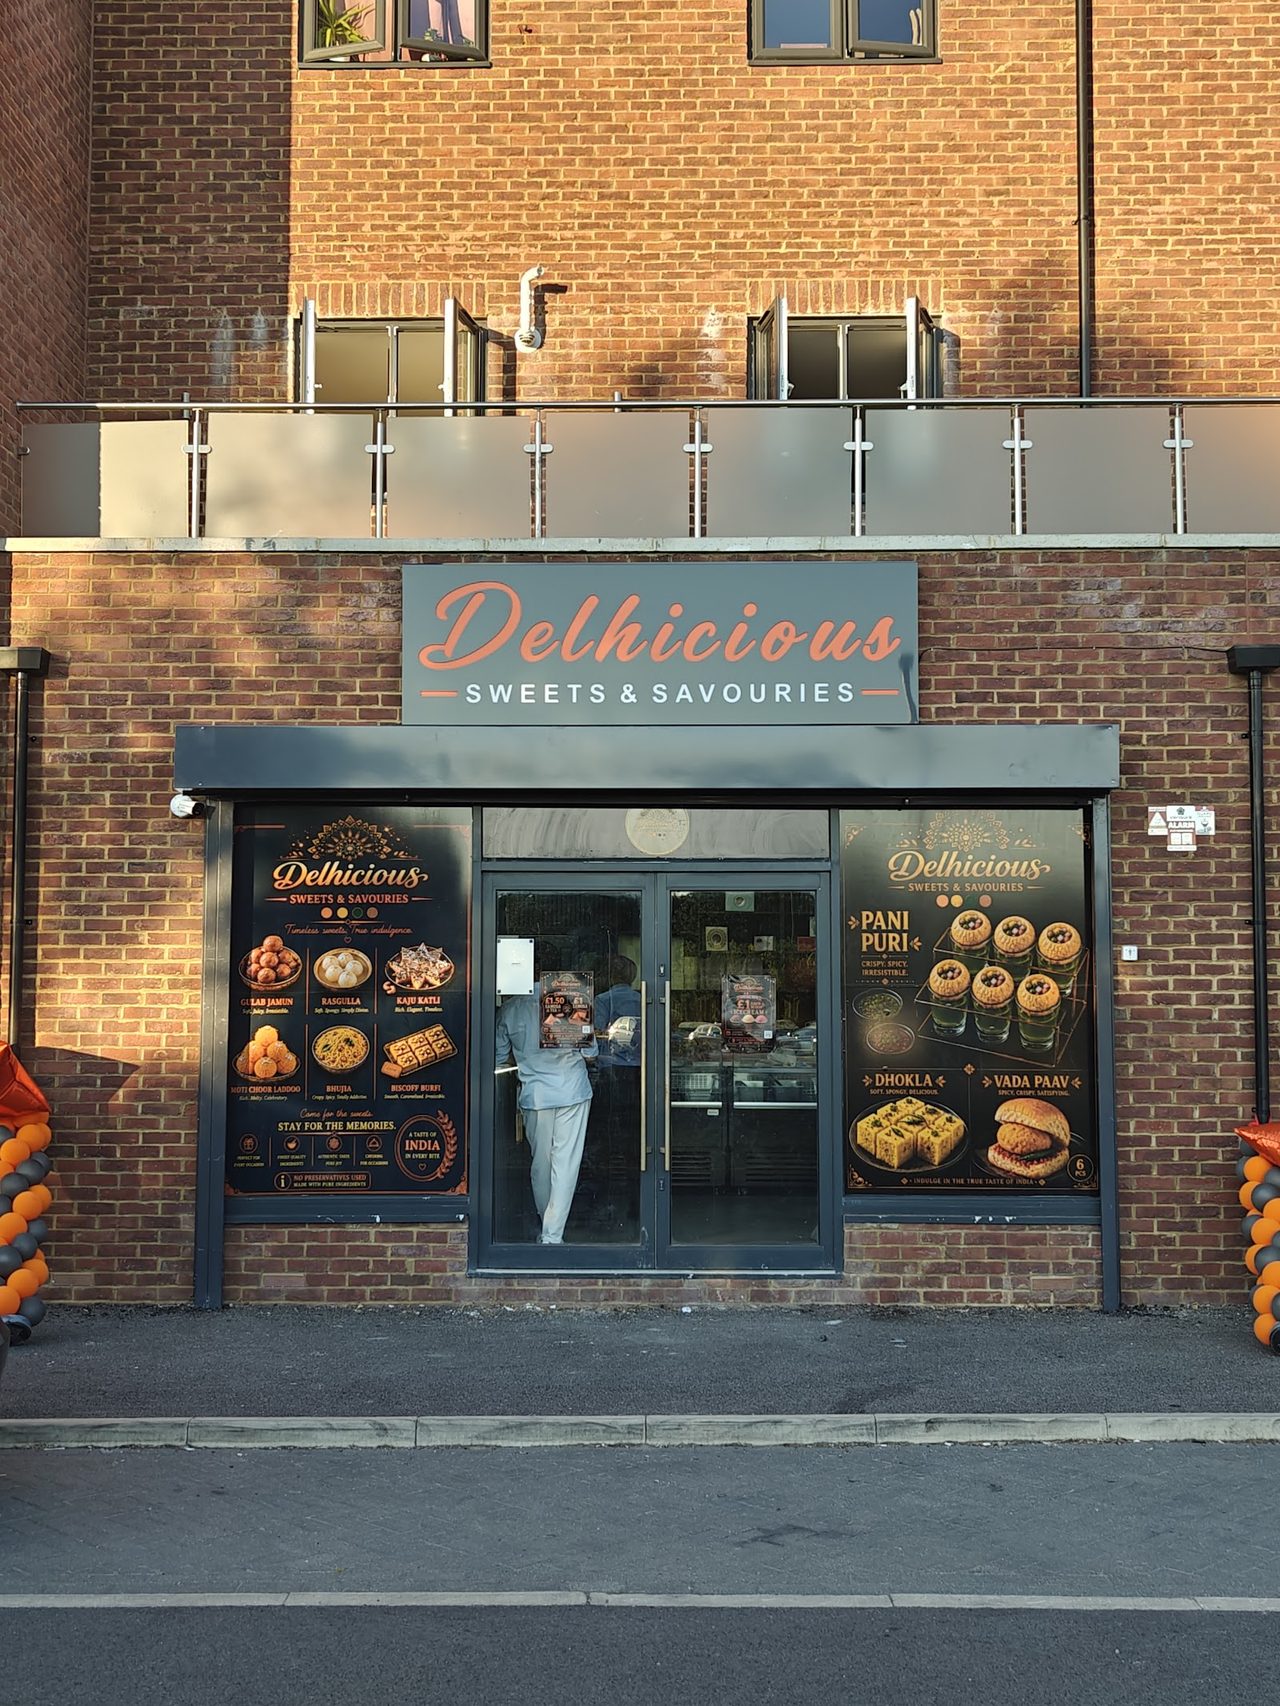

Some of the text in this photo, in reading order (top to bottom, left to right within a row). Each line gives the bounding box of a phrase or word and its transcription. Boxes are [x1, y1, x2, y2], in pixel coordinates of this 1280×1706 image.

[418, 580, 901, 671] Delhicious
[465, 682, 855, 703] SWEETS & SAVOURIES
[888, 850, 1051, 881] Delhicious
[273, 860, 429, 890] Delhicious
[908, 883, 1024, 892] SWEETS & SAVOURIES
[289, 894, 409, 904] SWEETS & SAVOURIES
[861, 910, 909, 930] PANI
[285, 924, 320, 934] Timeless
[348, 924, 368, 934] True
[861, 932, 909, 952] PURI
[240, 997, 293, 1007] GULAB JAMUN
[321, 997, 361, 1006] RASGULLA
[396, 996, 441, 1006] KAJU KATLI
[737, 999, 750, 1010] £1
[875, 1073, 933, 1087] DHOKLA
[994, 1075, 1069, 1088] VADA PAAV
[248, 1086, 273, 1094] CHOOR
[326, 1085, 352, 1093] BHUJIA
[391, 1084, 441, 1092] BISCOFF BURFI
[300, 1107, 321, 1119] Come
[322, 1108, 334, 1120] for
[336, 1108, 347, 1117] the
[278, 1121, 397, 1131] STAY FOR THE MEMORIES.
[405, 1140, 440, 1151] INDIA
[1076, 1158, 1085, 1170] 6
[1015, 1178, 1034, 1186] INDIA
